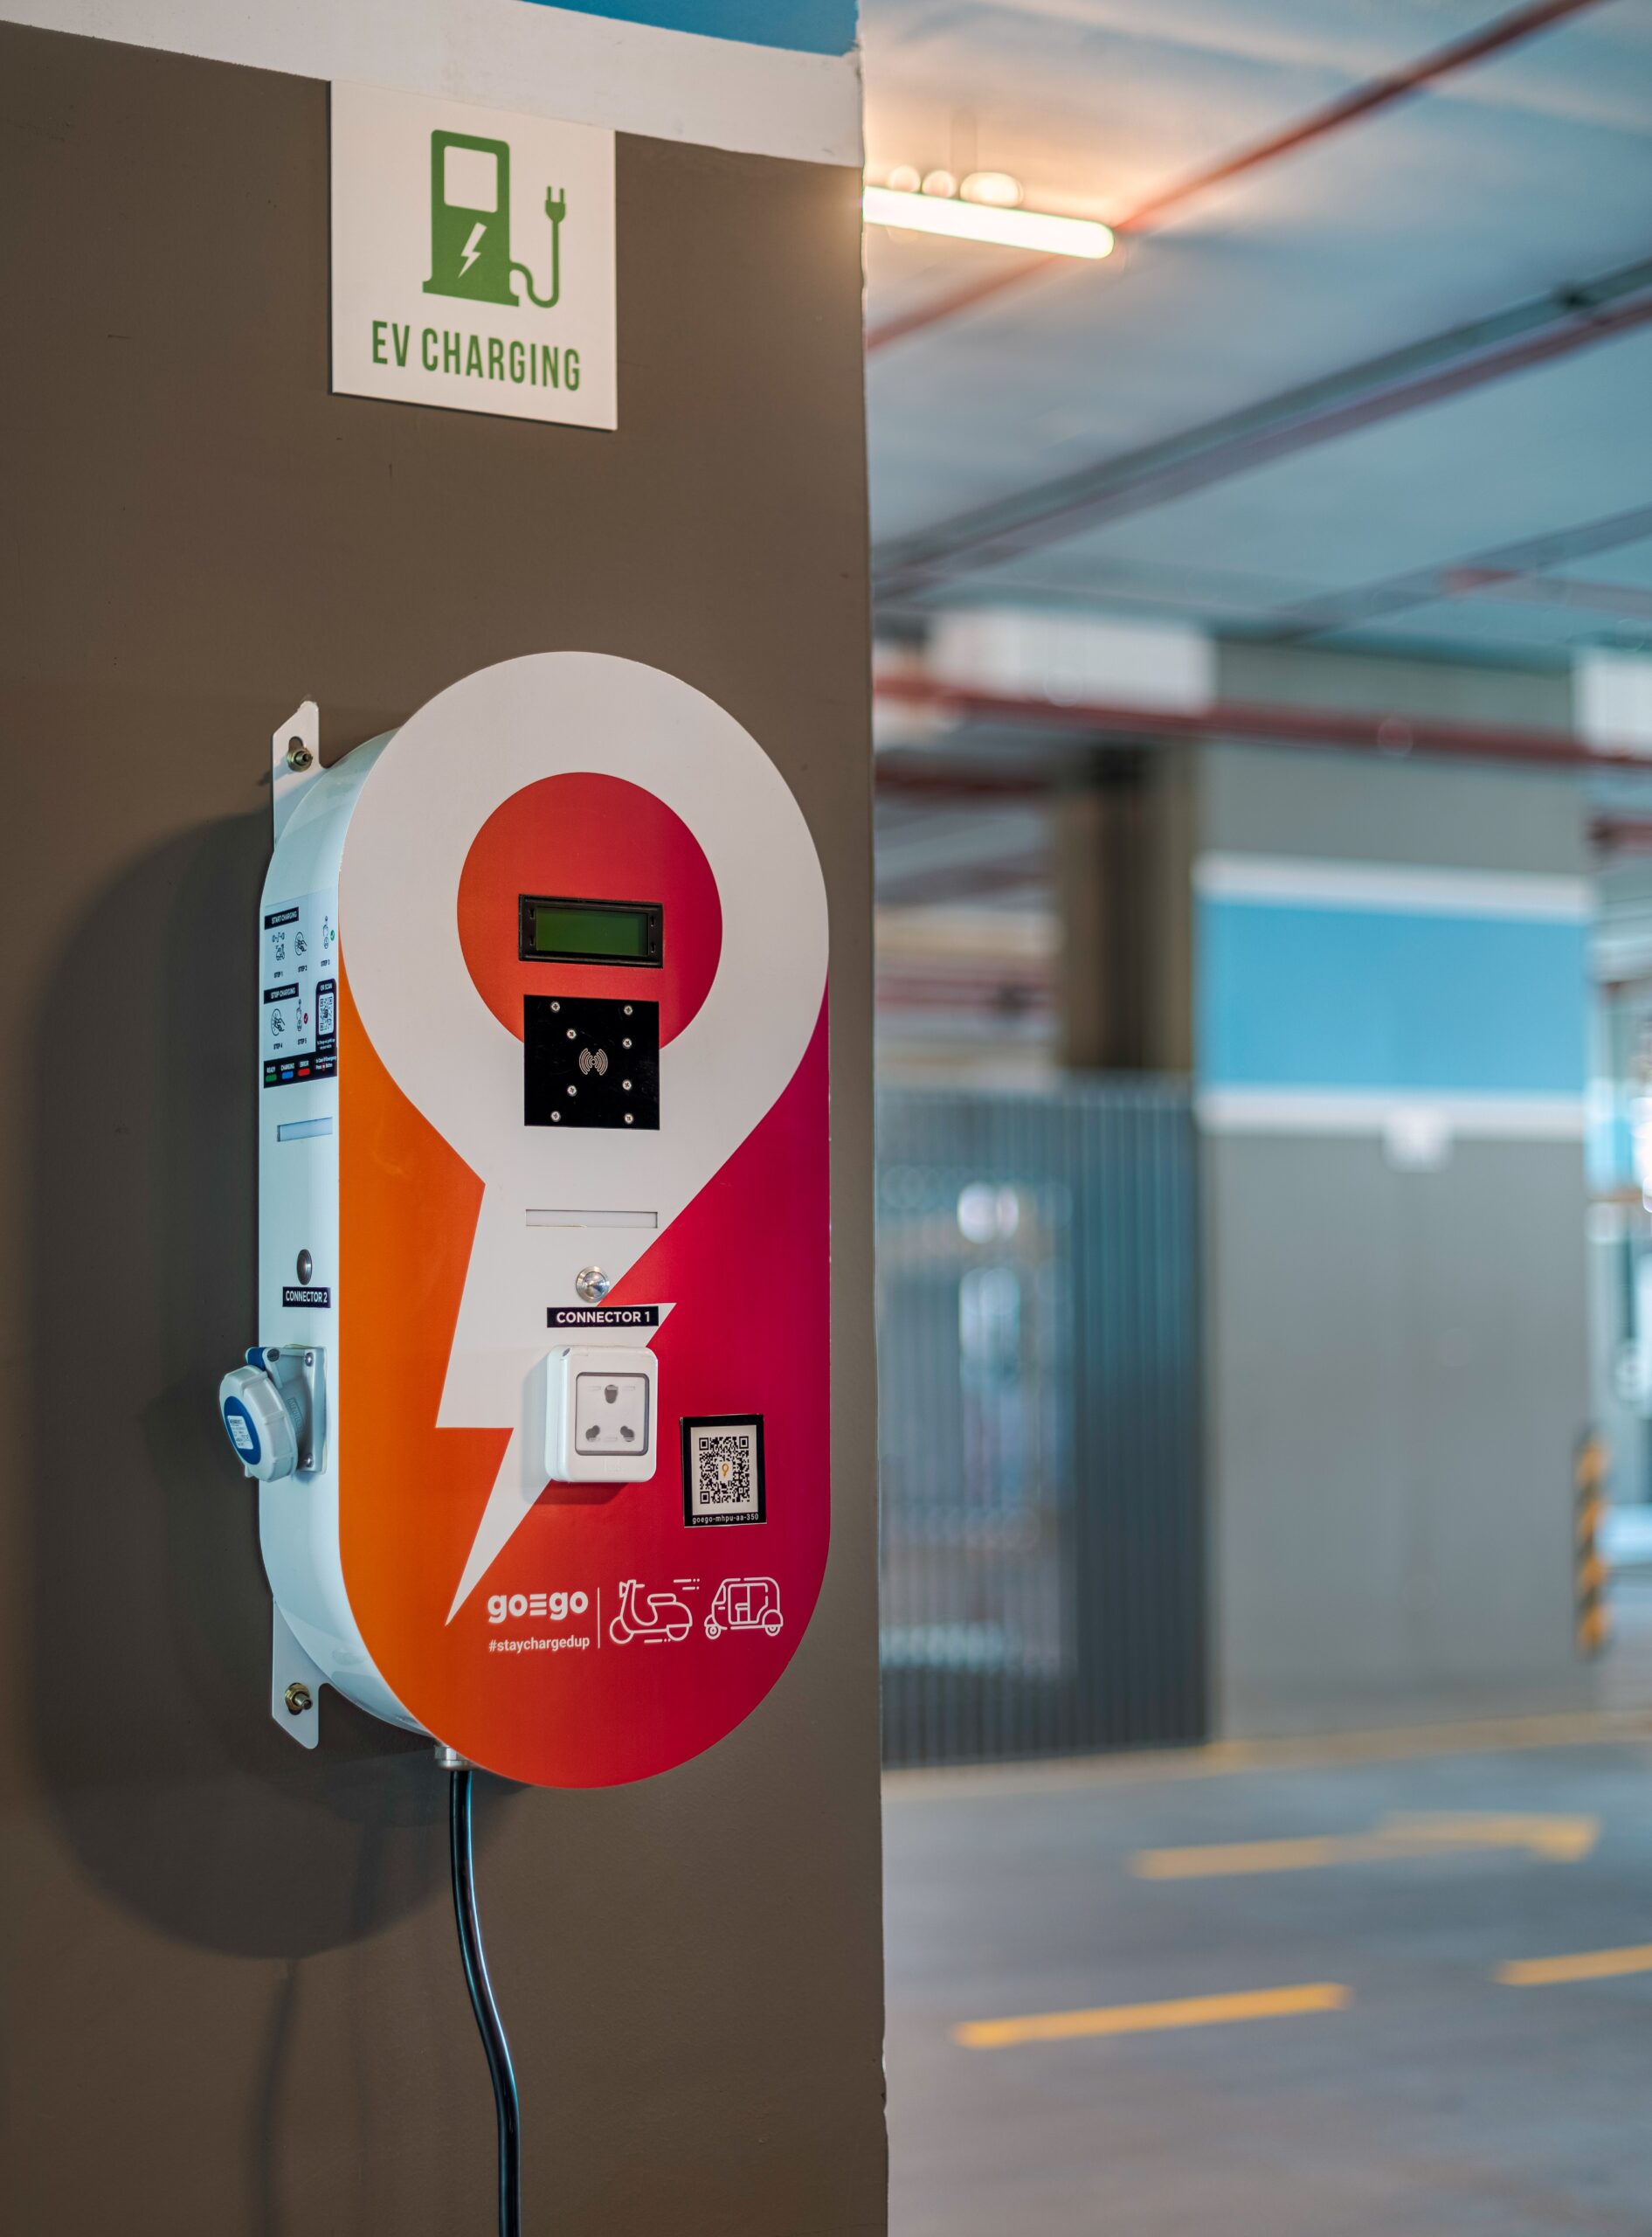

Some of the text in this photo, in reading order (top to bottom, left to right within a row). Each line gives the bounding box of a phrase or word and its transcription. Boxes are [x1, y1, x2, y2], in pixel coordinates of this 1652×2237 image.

[372, 320, 580, 391] EV CHARGING
[271, 987, 296, 999] STOP CHARGING
[286, 1290, 328, 1303] CONNECTOR 2
[556, 1311, 650, 1323] CONNECTOR 1
[489, 1634, 590, 1654] #staychargedup
